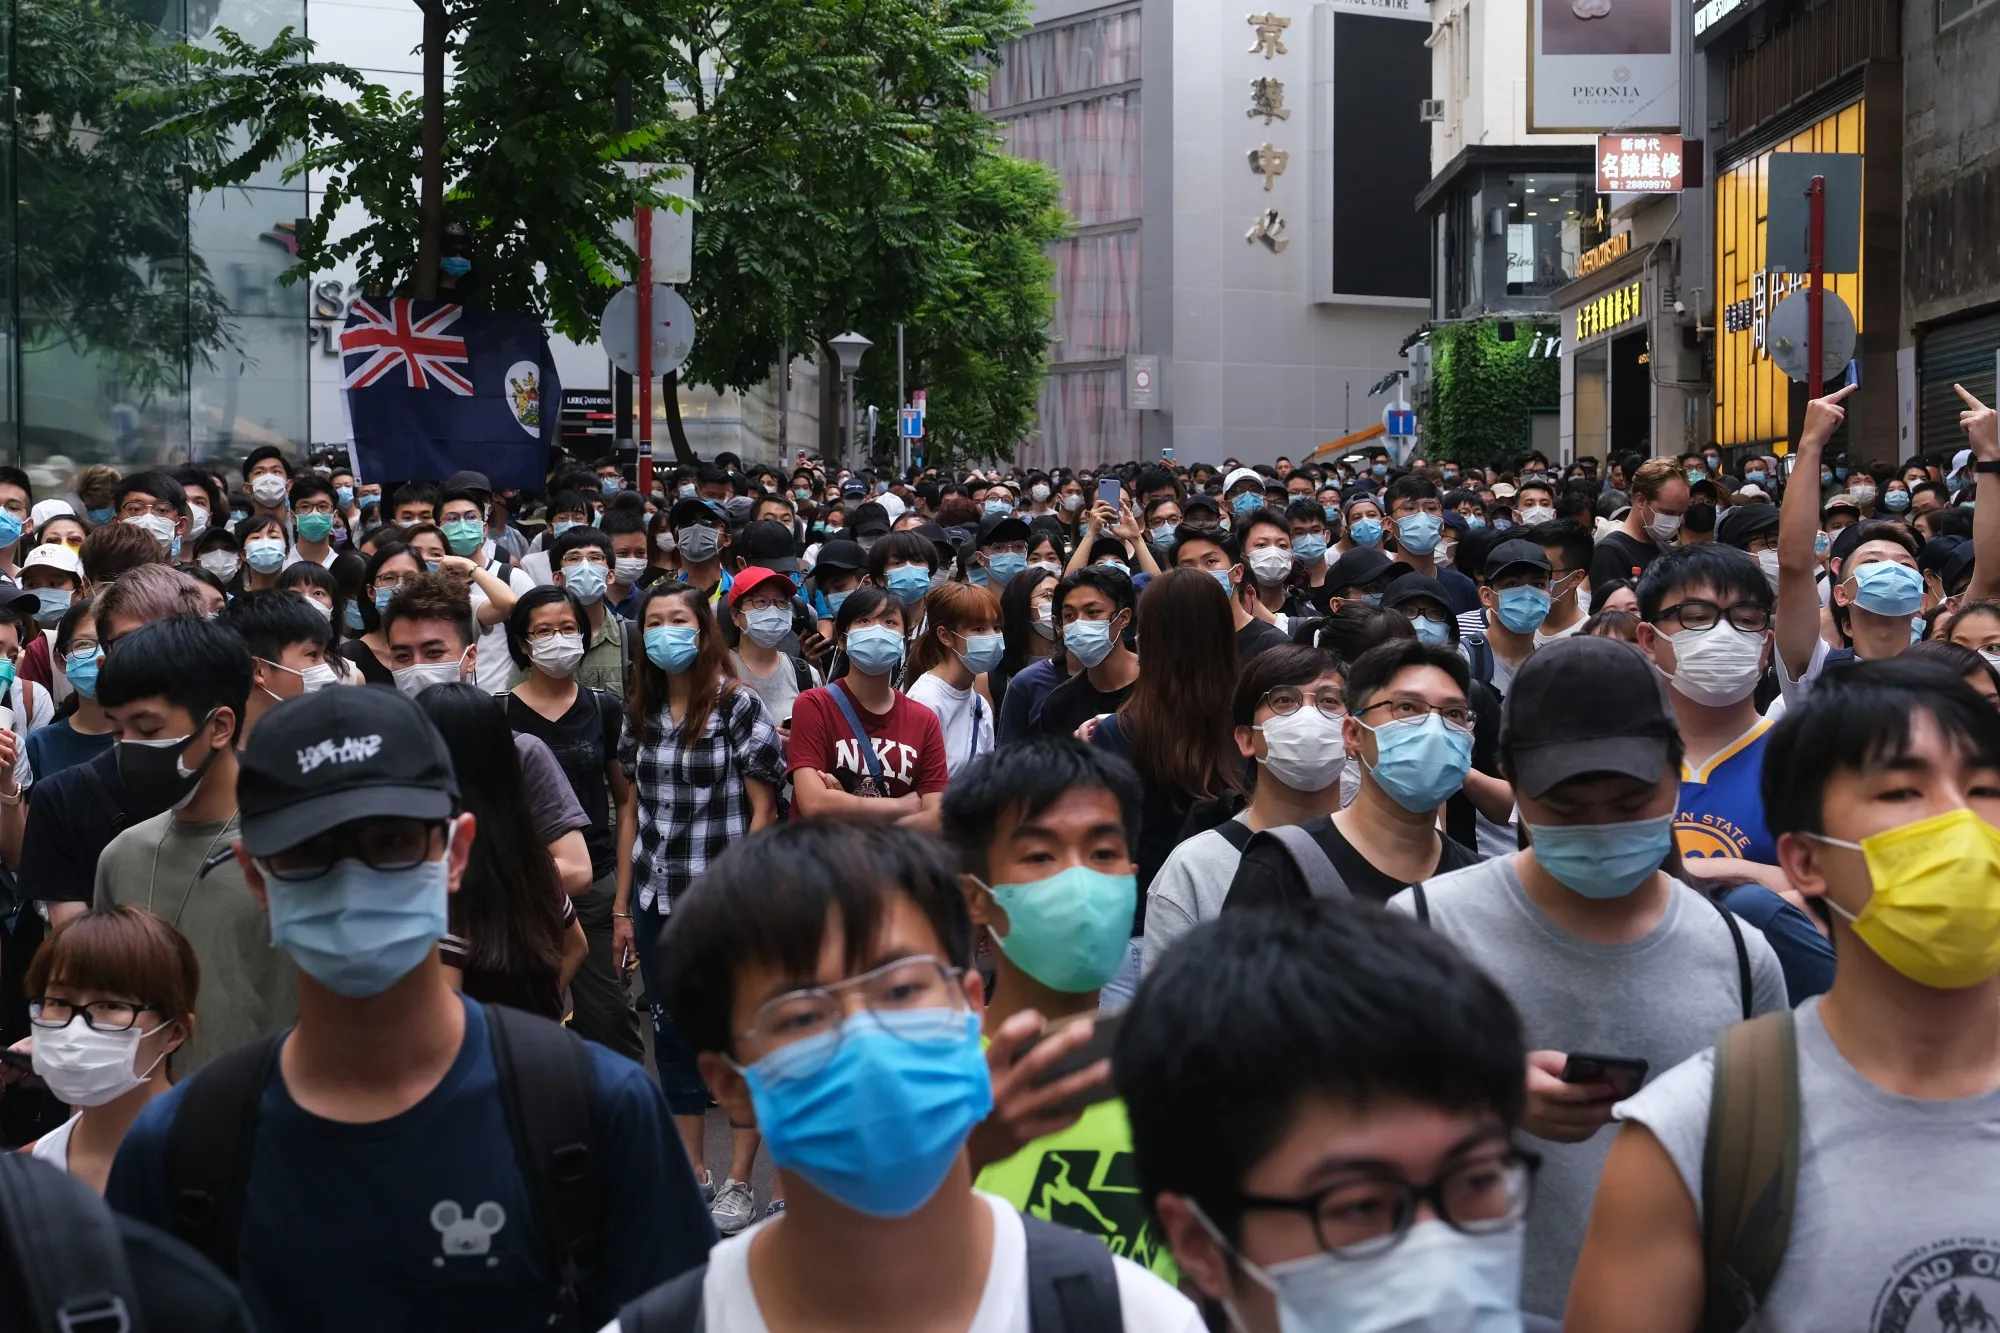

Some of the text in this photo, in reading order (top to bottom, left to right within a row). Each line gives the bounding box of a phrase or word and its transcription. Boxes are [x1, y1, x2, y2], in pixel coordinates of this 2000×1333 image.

[1573, 86, 1640, 97] PEONIA
[1621, 138, 1660, 151] 新時代
[1702, 814, 1751, 848] STATE
